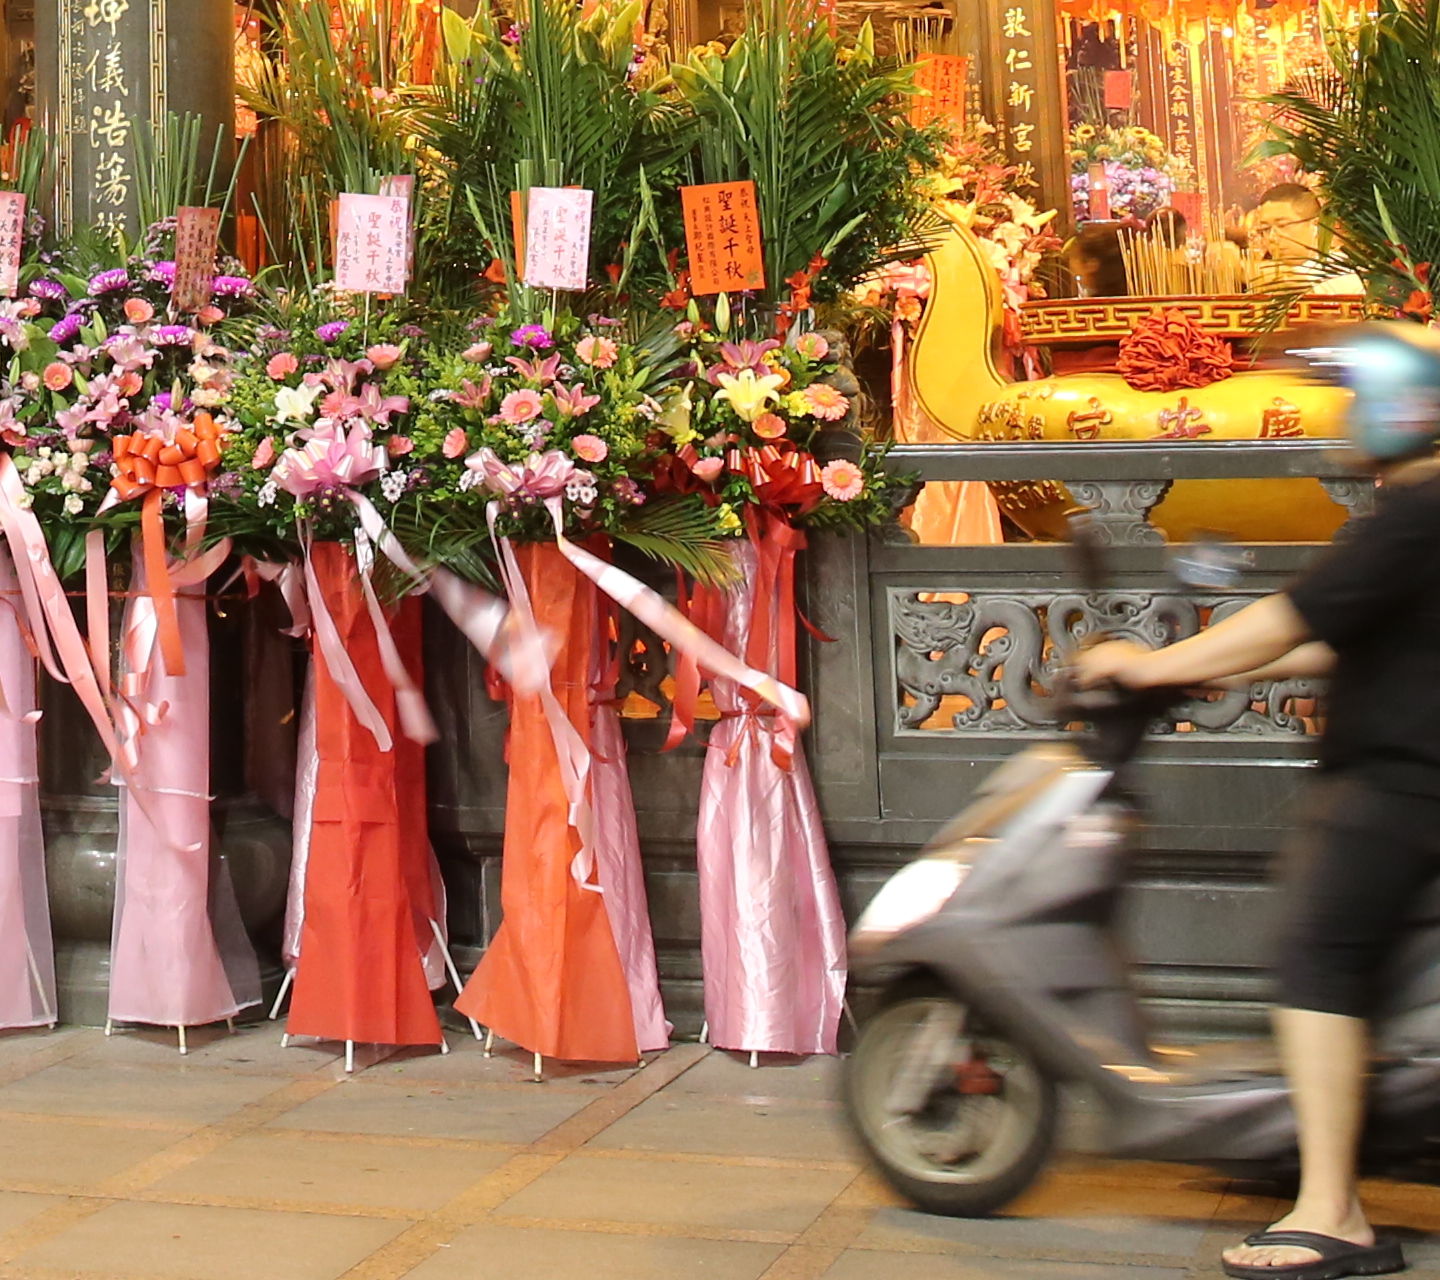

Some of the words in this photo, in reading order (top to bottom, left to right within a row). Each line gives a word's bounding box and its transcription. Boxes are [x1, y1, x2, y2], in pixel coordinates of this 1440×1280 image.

[365, 211, 383, 285] 聖誕千秋
[390, 199, 404, 230] 恭祝
[552, 206, 568, 279] 聖誕千秋
[718, 190, 744, 280] 聖誕千秋
